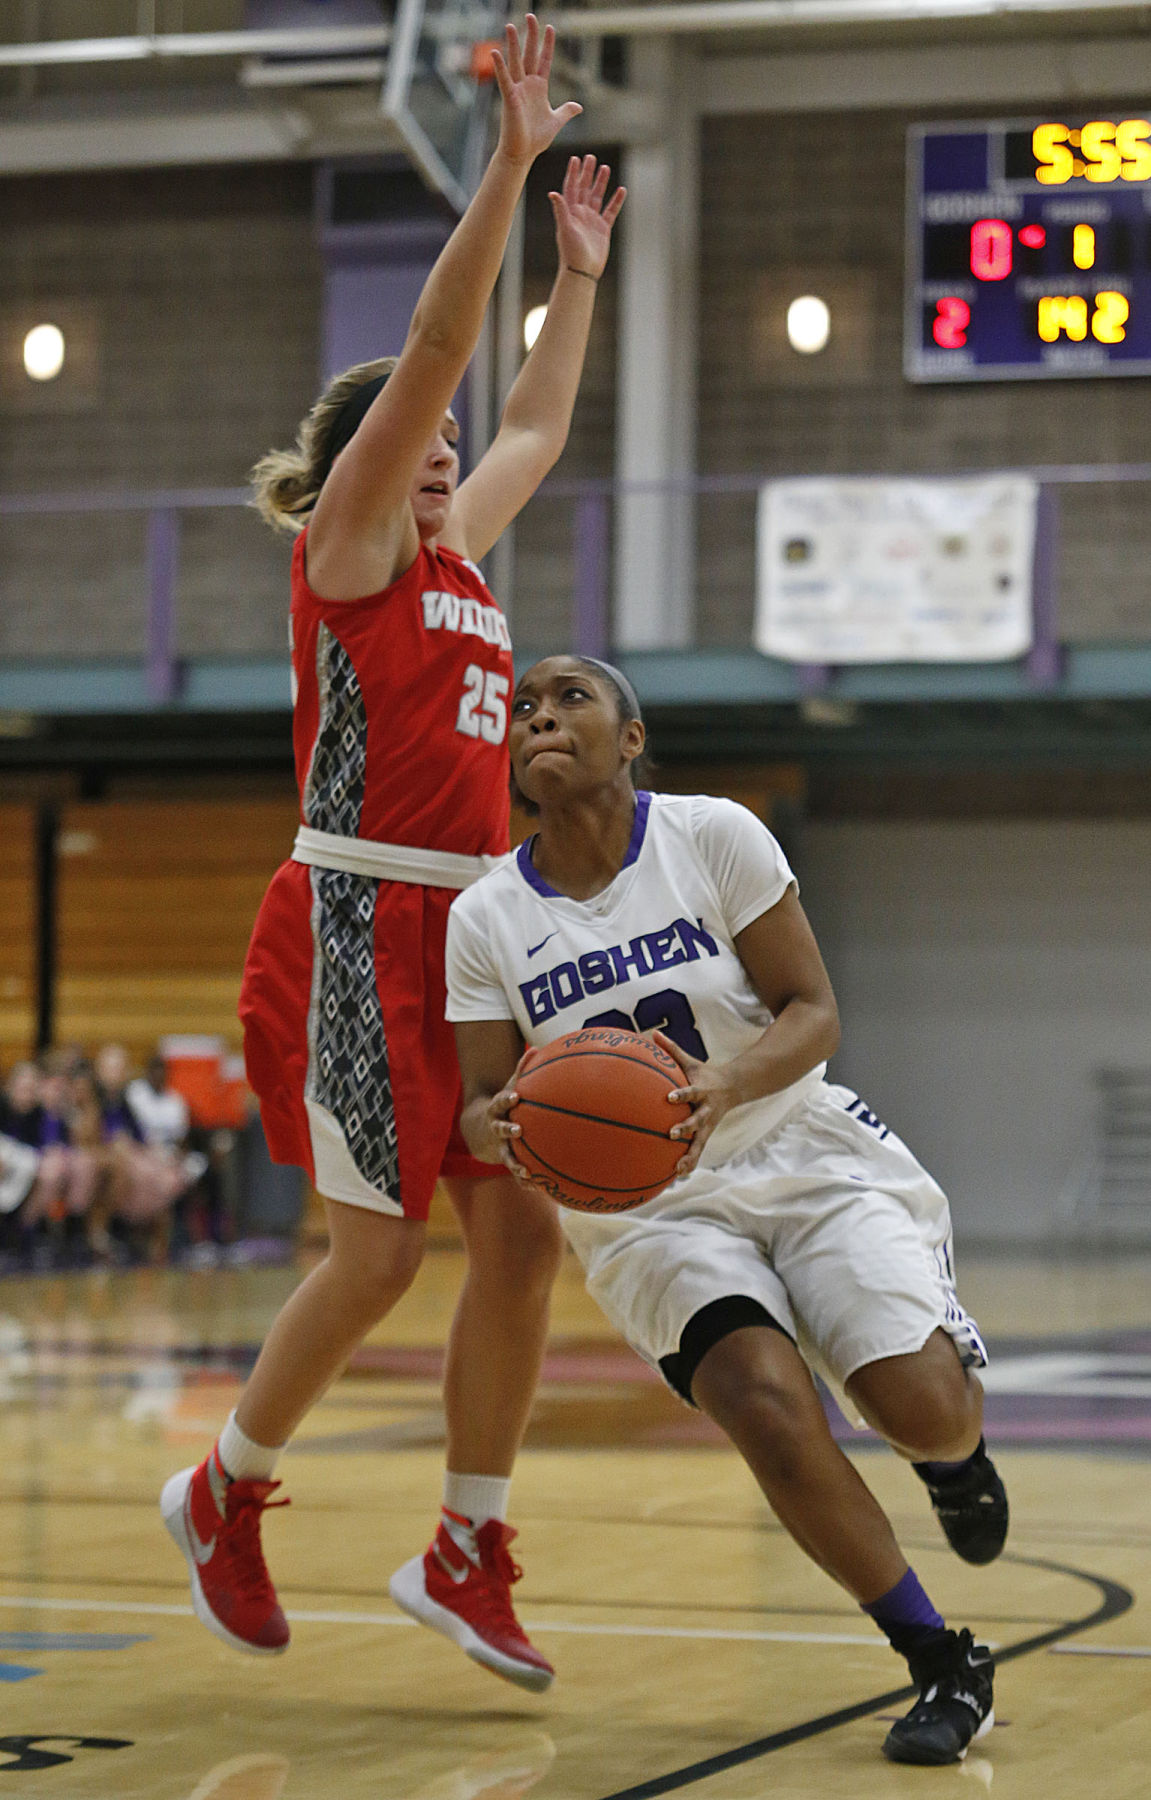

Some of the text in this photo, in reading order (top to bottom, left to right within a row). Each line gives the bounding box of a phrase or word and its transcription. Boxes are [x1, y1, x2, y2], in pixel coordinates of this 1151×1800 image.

[1073, 223, 1095, 270] 1
[455, 663, 510, 746] 25
[518, 917, 720, 1028] GOSHEN
[563, 1029, 677, 1069] Rawlings
[531, 1173, 645, 1213] Rawlings
